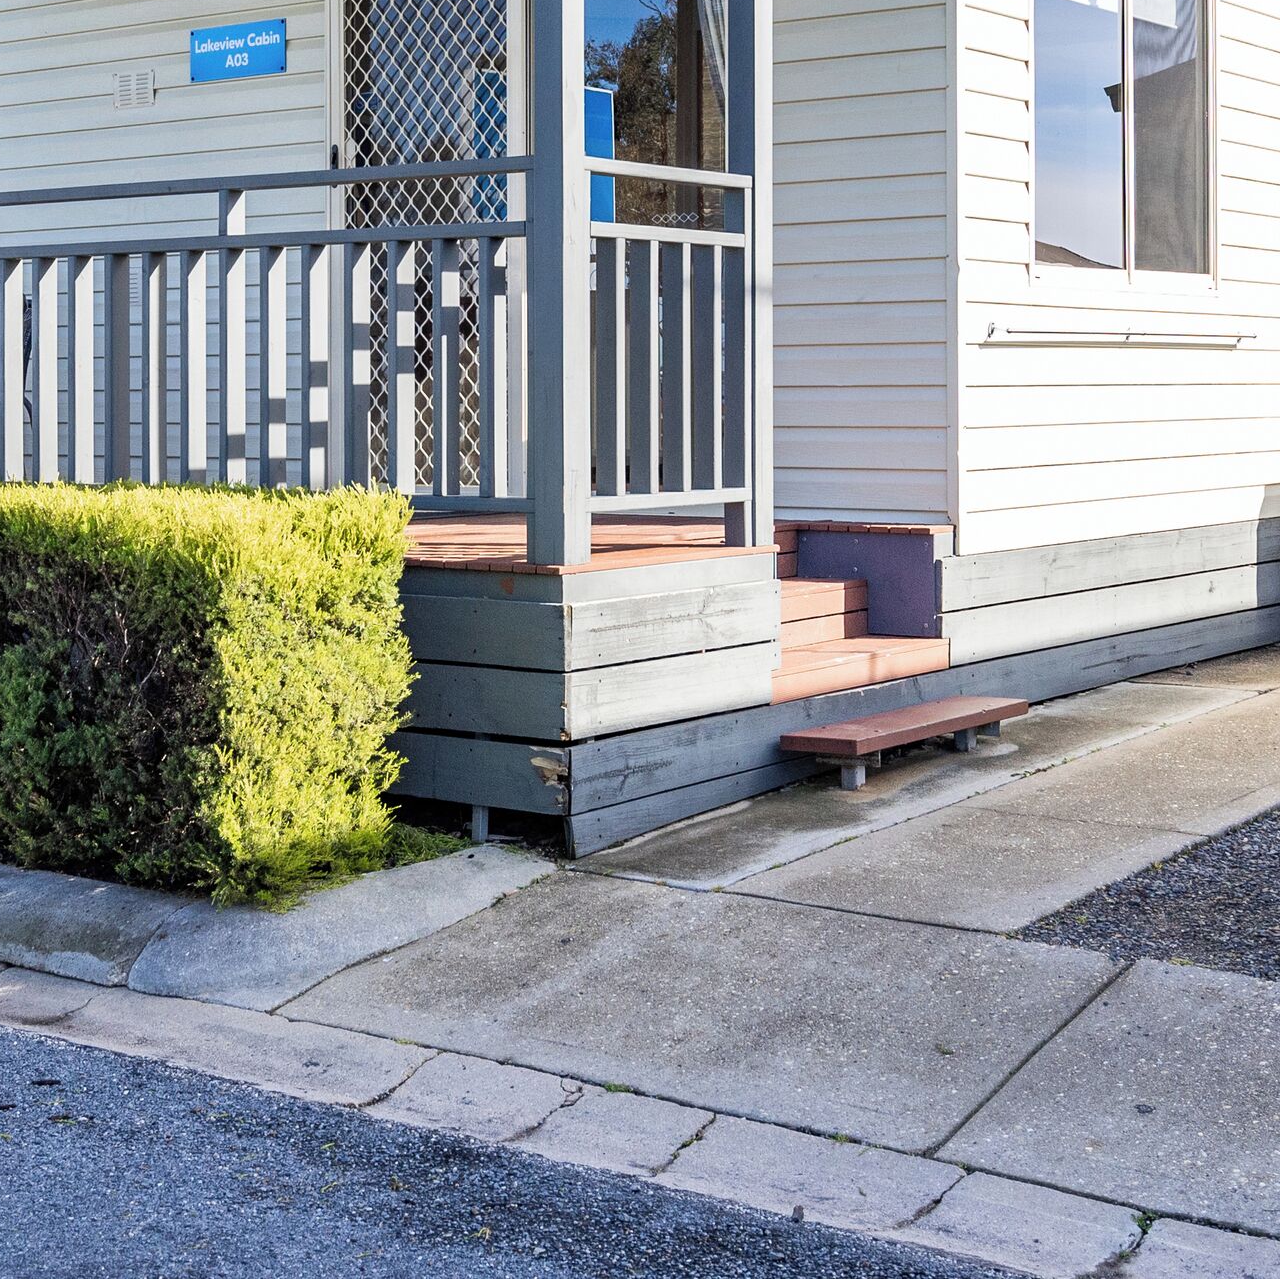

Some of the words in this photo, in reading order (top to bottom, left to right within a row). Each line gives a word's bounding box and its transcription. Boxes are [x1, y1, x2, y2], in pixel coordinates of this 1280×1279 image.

[195, 37, 245, 53] Lakeview
[247, 31, 280, 46] Cabin
[225, 53, 249, 68] A03
